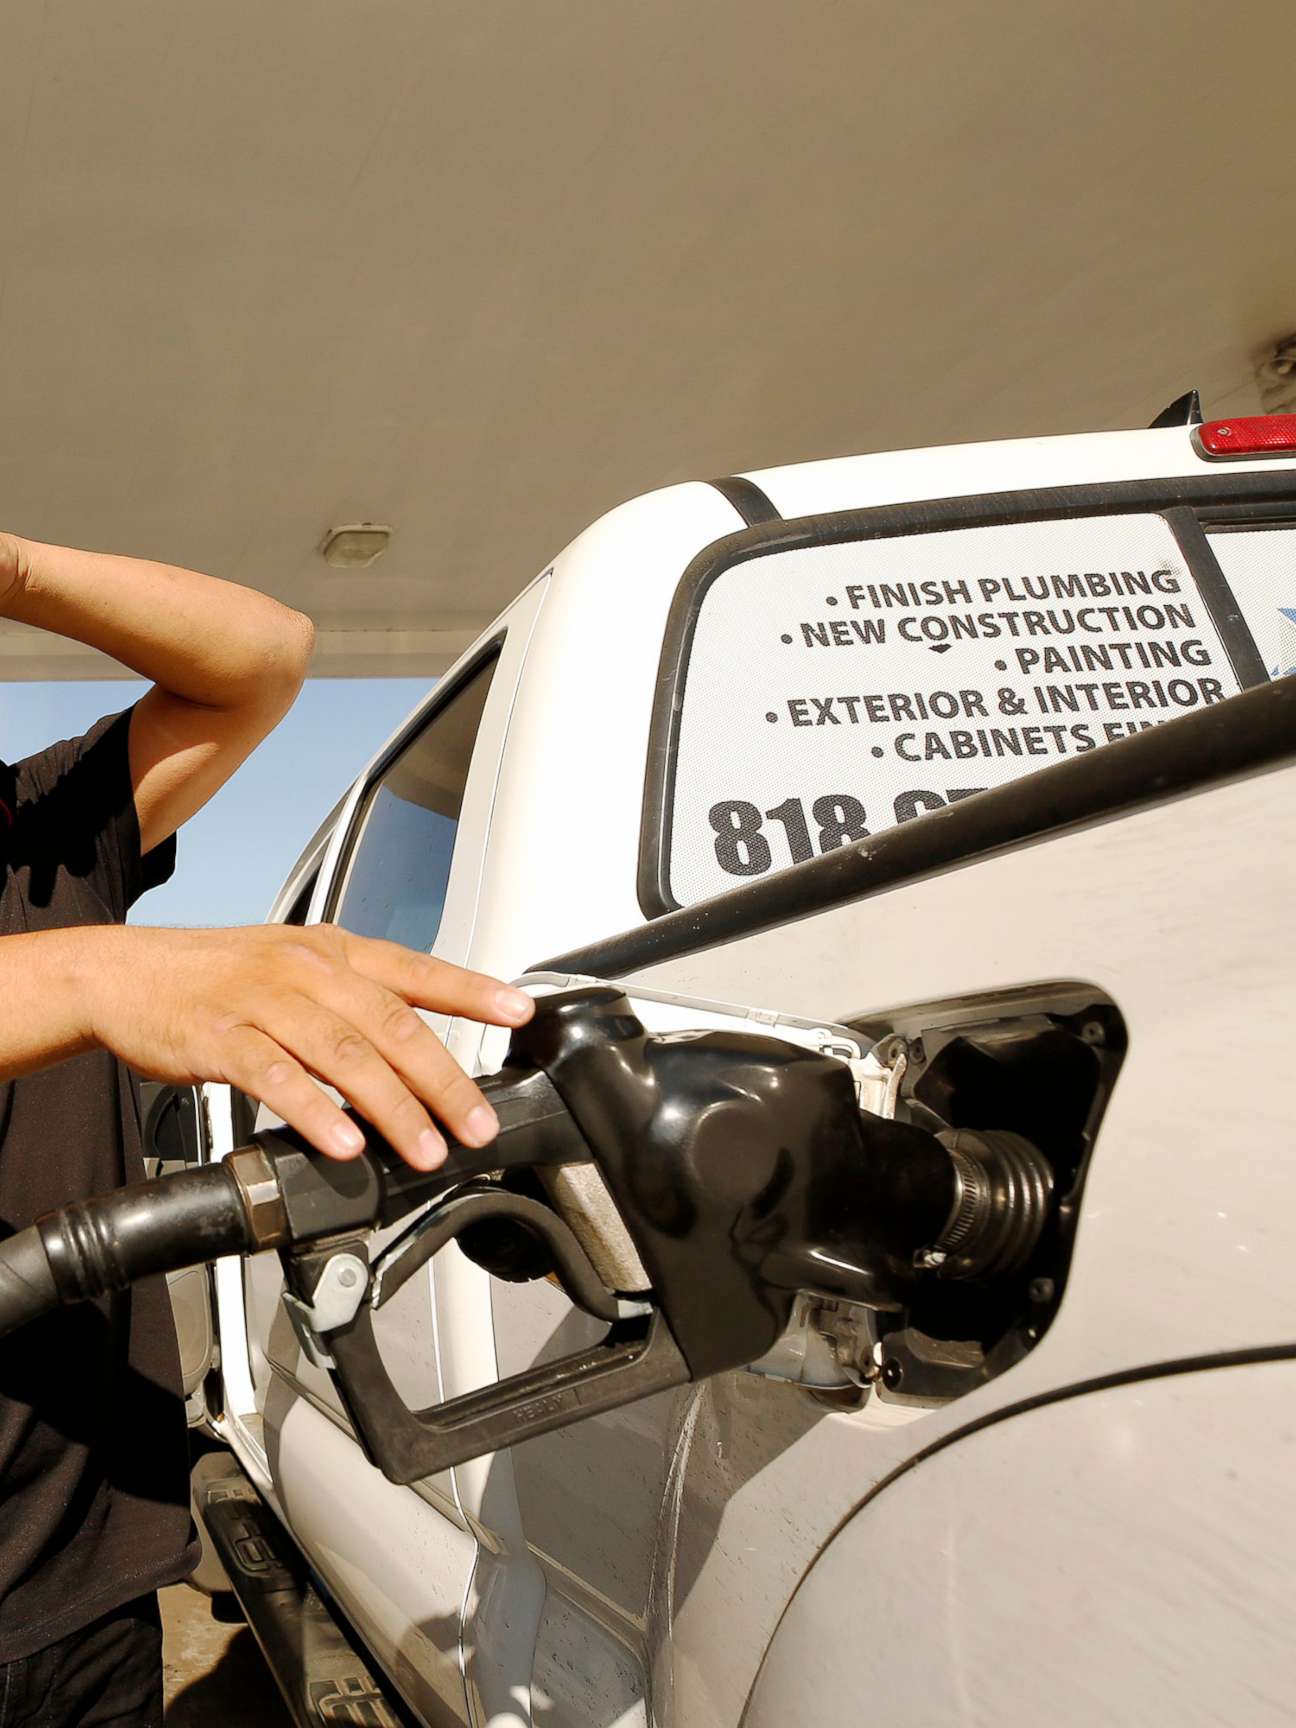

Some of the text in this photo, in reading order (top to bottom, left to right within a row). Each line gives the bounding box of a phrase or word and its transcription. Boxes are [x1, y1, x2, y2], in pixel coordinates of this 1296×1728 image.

[845, 570, 1181, 609] FINISH PLUMBING
[800, 603, 1196, 648] NEW CONSTRUCTION
[1015, 639, 1212, 675] PAINTING
[787, 677, 1227, 727] EXTERIOR & INTERIOR
[894, 720, 1164, 763] CABINETS FI
[708, 794, 871, 876] 818
